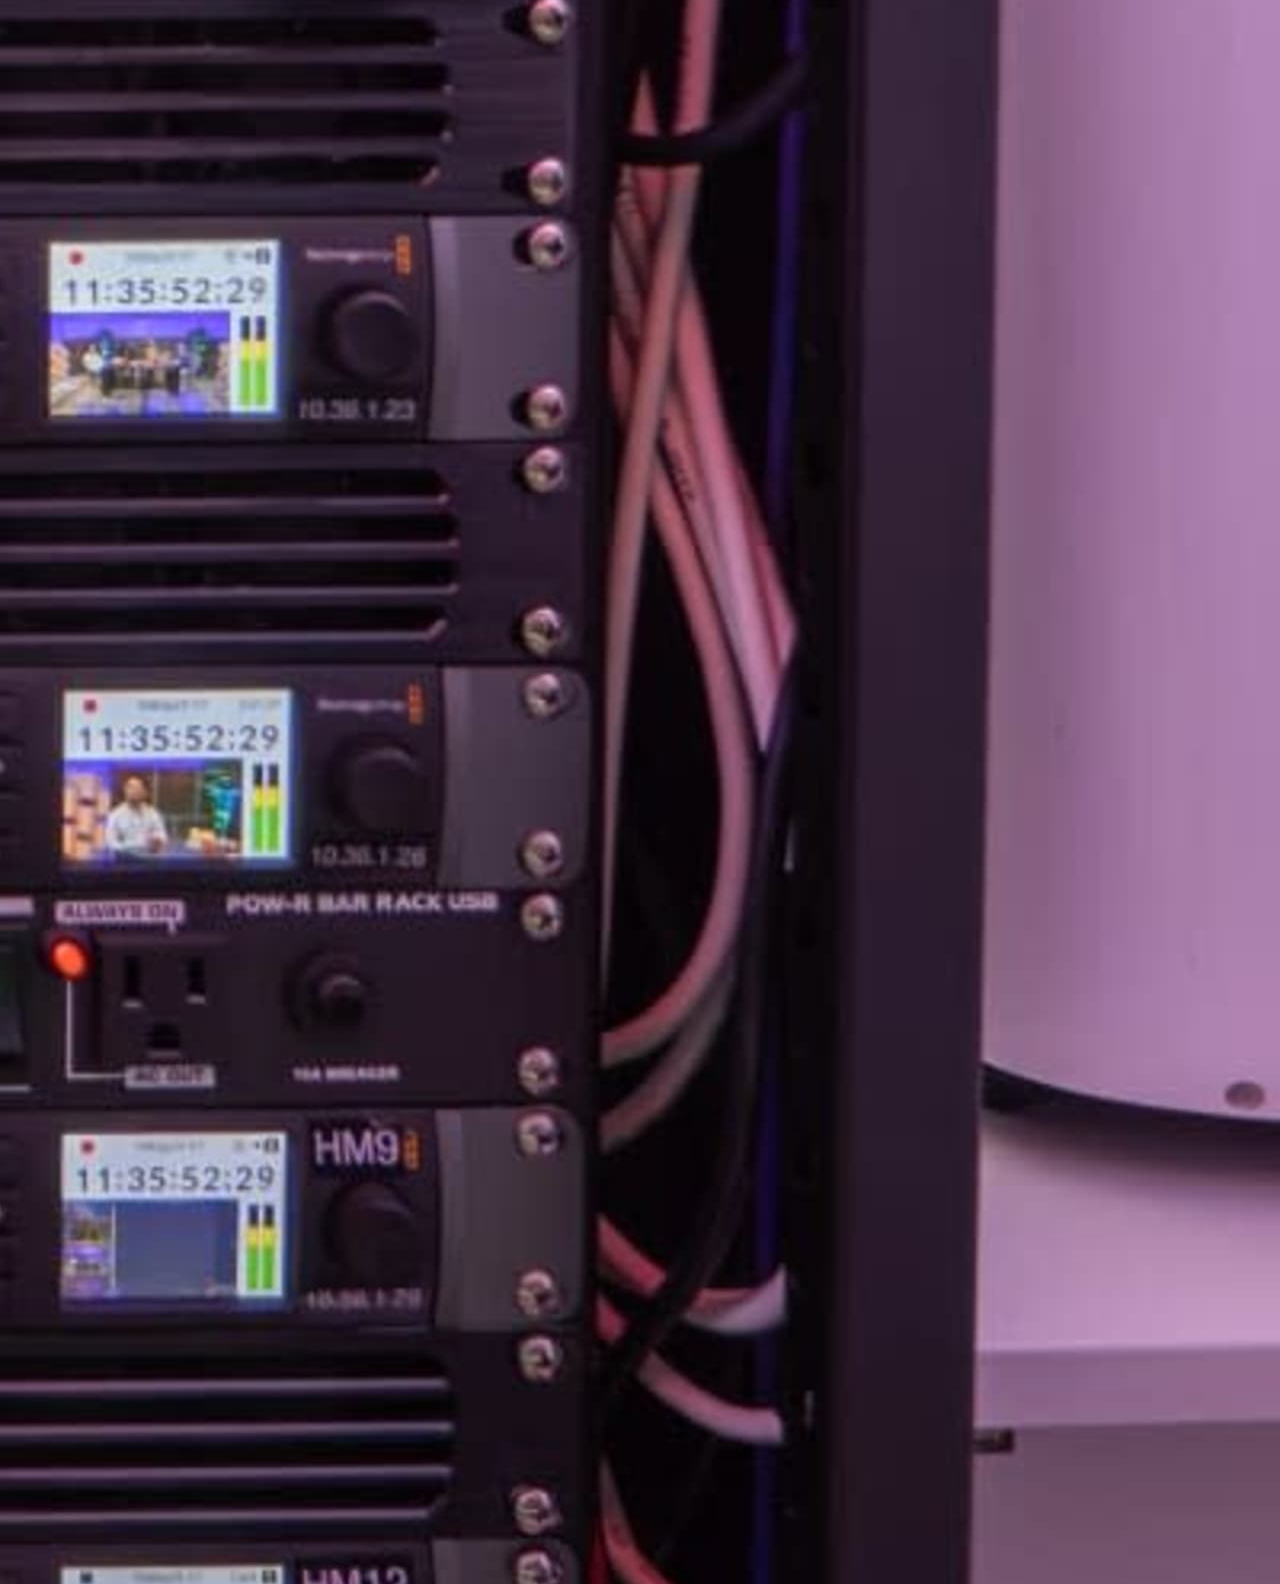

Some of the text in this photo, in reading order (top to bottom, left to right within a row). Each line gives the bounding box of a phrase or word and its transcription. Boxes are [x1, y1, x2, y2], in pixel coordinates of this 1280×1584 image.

[62, 902, 145, 921] ALWAYS
[226, 891, 499, 915] POW-R BAR RACK USB
[314, 1129, 400, 1166] HM9
